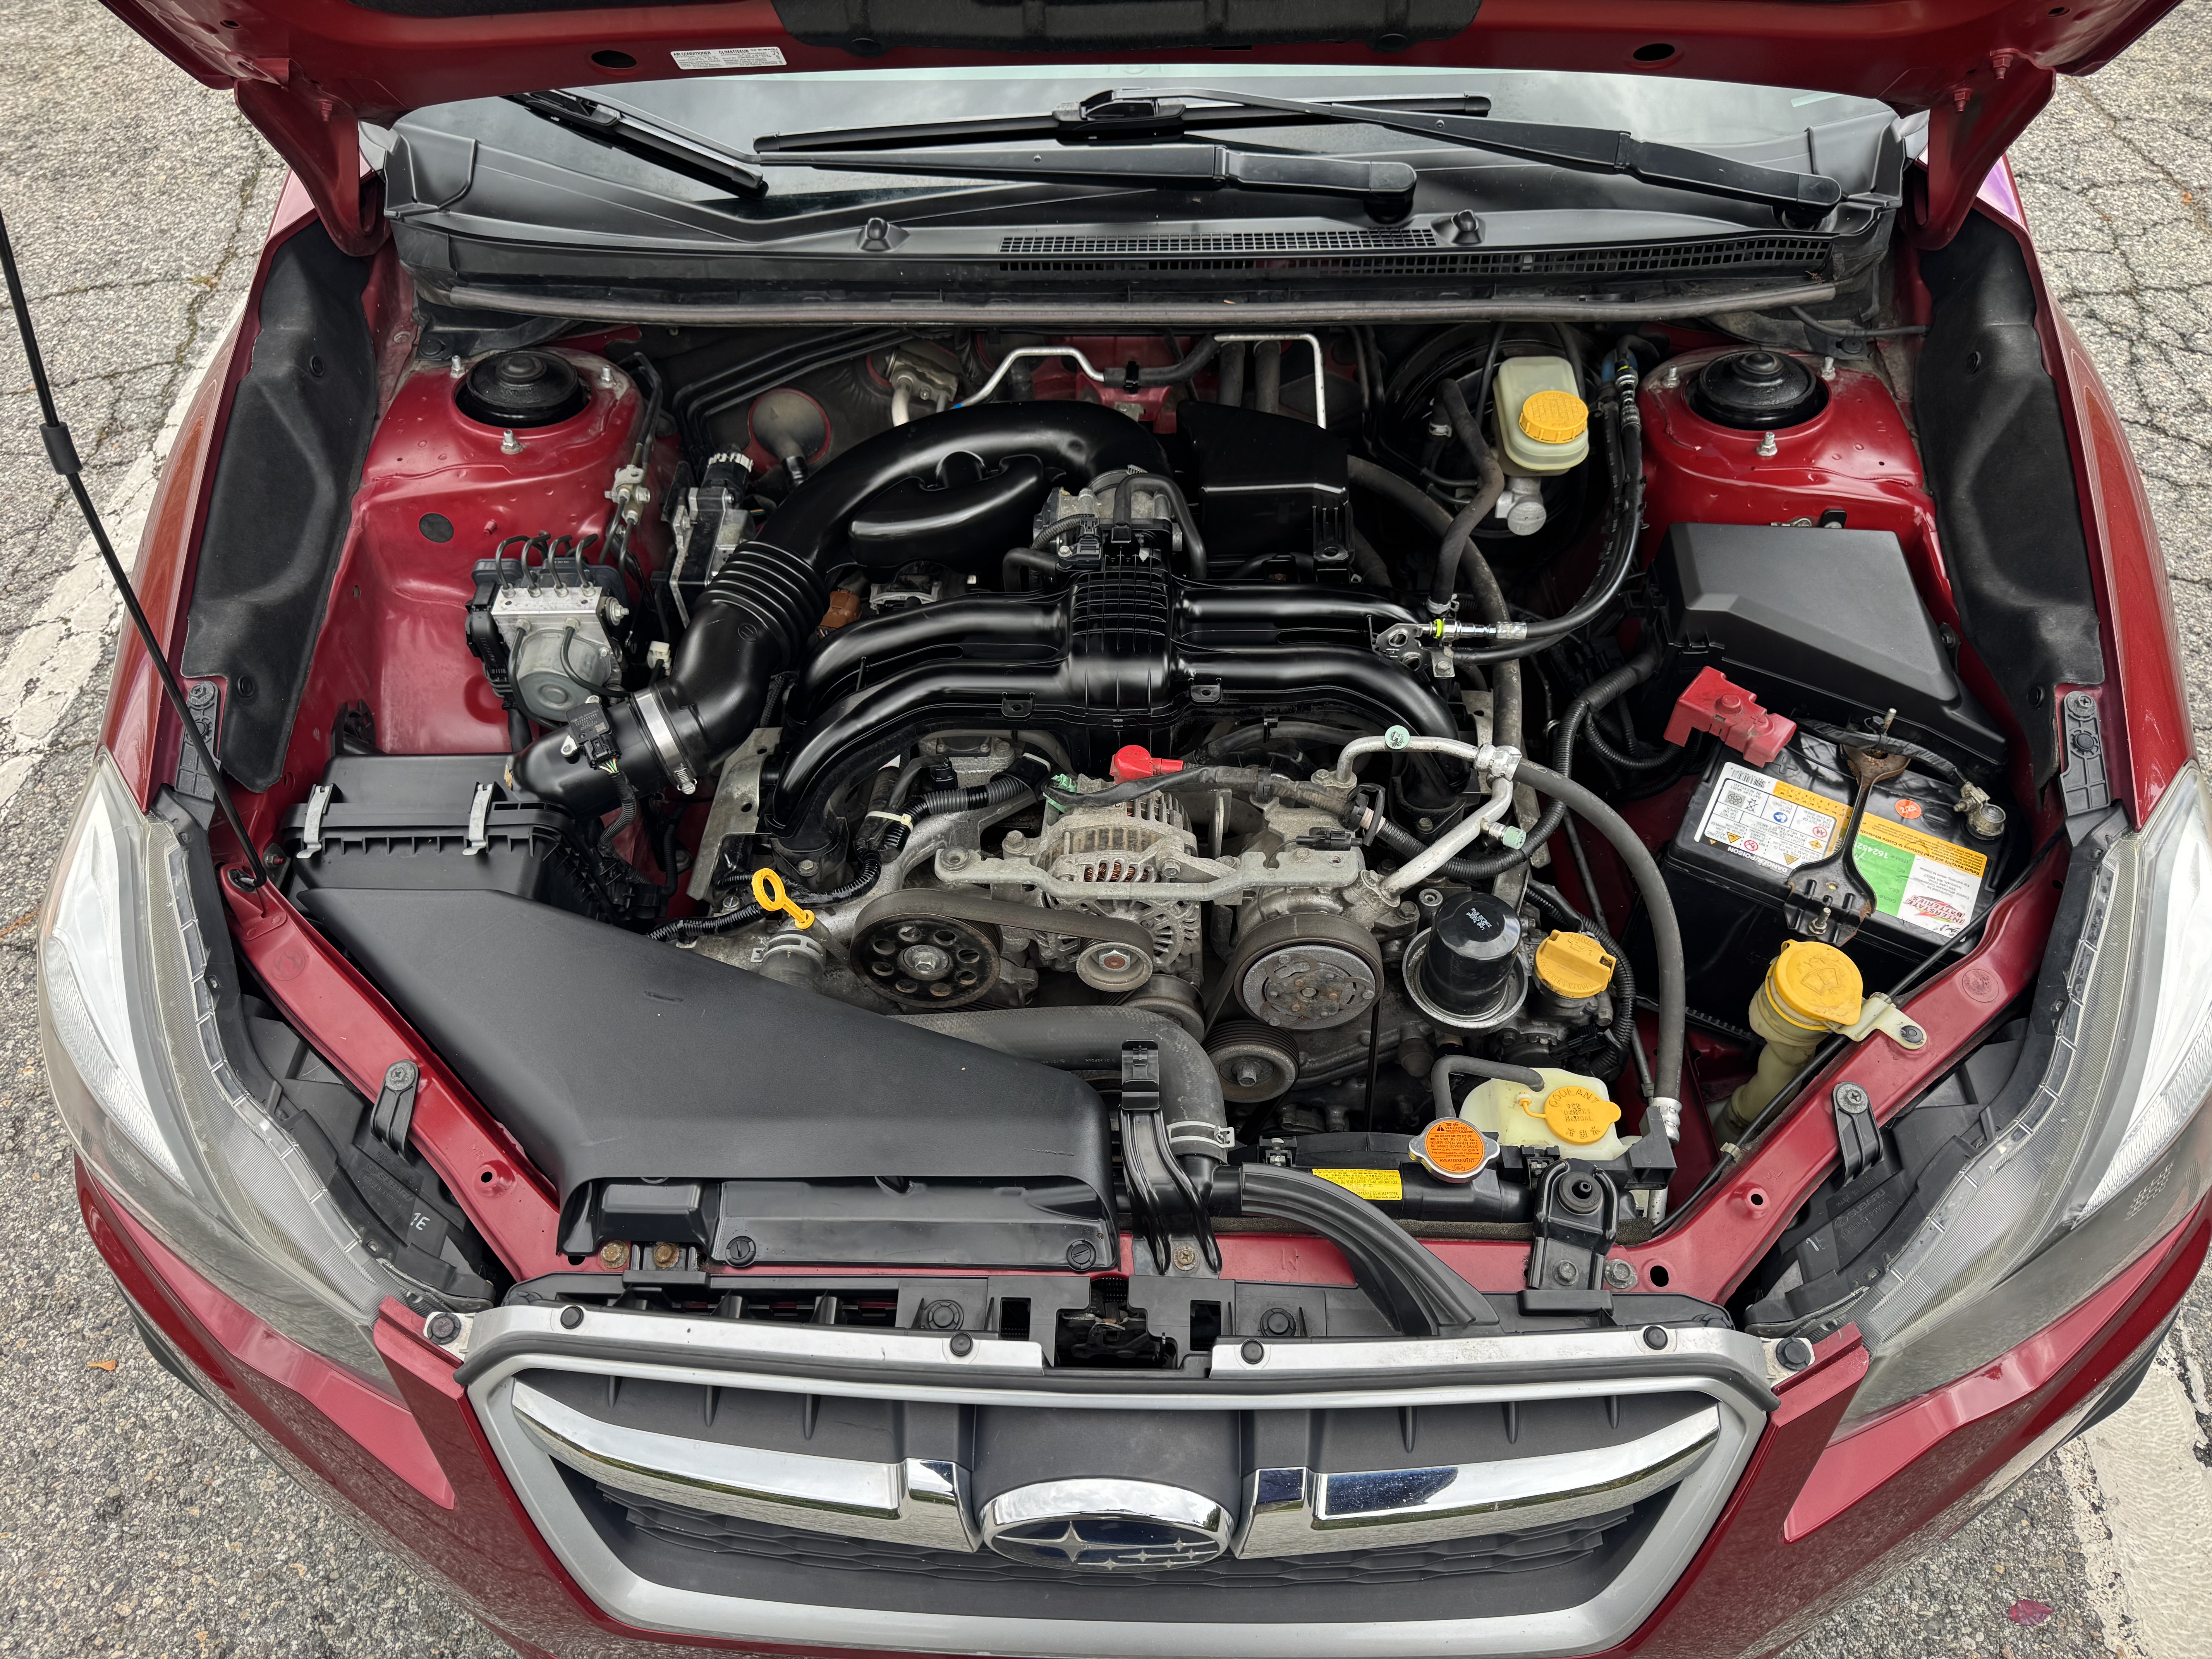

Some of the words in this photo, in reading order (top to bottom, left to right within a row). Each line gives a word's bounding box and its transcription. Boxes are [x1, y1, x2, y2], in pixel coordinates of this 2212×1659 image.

[1899, 803, 1918, 816] 2/25
[1859, 829, 1881, 840] Wholesale
[1882, 837, 1897, 845] Costco
[1903, 845, 1923, 855] batteries
[1727, 845, 1788, 873] DANGER/POISON
[1944, 859, 1964, 869] warranty
[1955, 860, 1980, 871] PROPOSITION
[1964, 867, 1980, 875] Return
[1878, 893, 1896, 903] GROUP
[1905, 898, 1964, 924] INTERSTATE
[1912, 895, 1963, 917] BATTERIES
[1549, 1088, 1600, 1107] COOLANT
[1836, 1194, 1851, 1207] MADE
[1860, 1176, 1877, 1190] JAPAN
[1847, 1189, 1886, 1218] SUBARU
[410, 1212, 430, 1231] 1E
